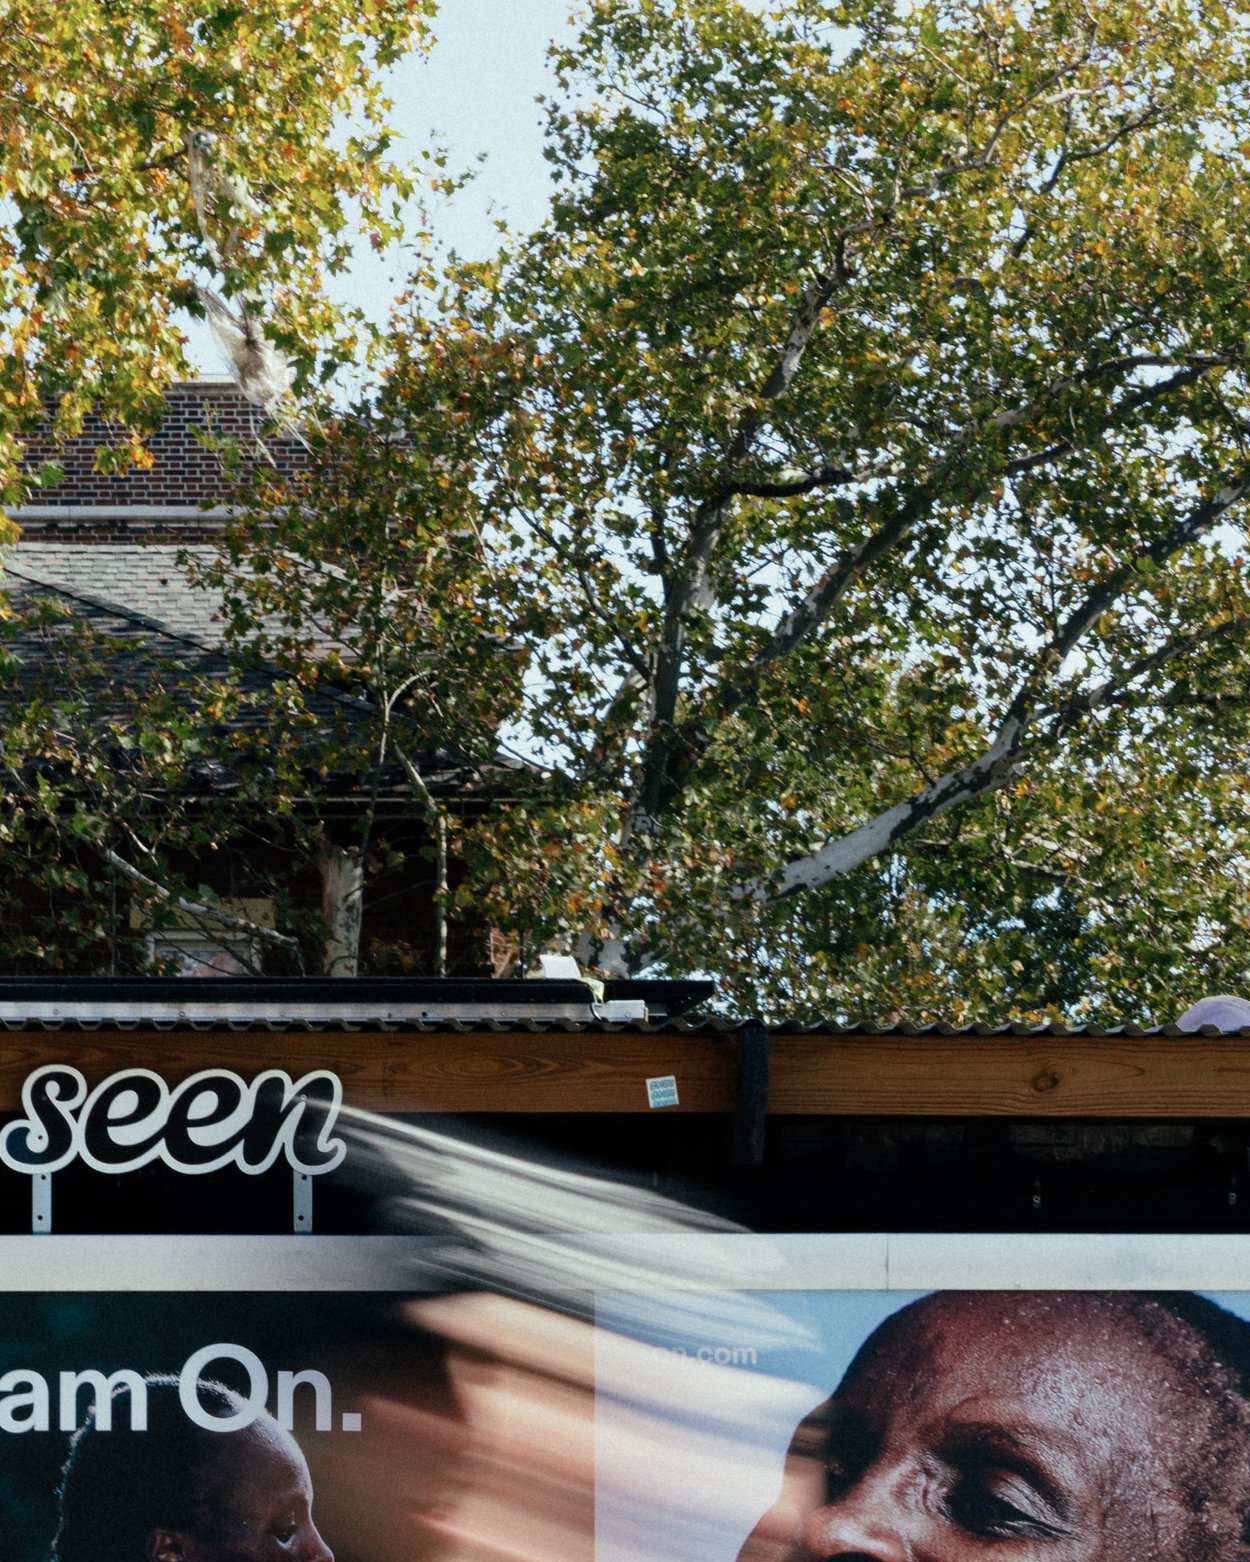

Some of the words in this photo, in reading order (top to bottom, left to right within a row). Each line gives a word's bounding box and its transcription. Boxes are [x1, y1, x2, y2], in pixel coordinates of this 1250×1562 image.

[0, 1064, 347, 1175] seen
[179, 1343, 362, 1433] On.
[653, 1346, 758, 1366] ncom
